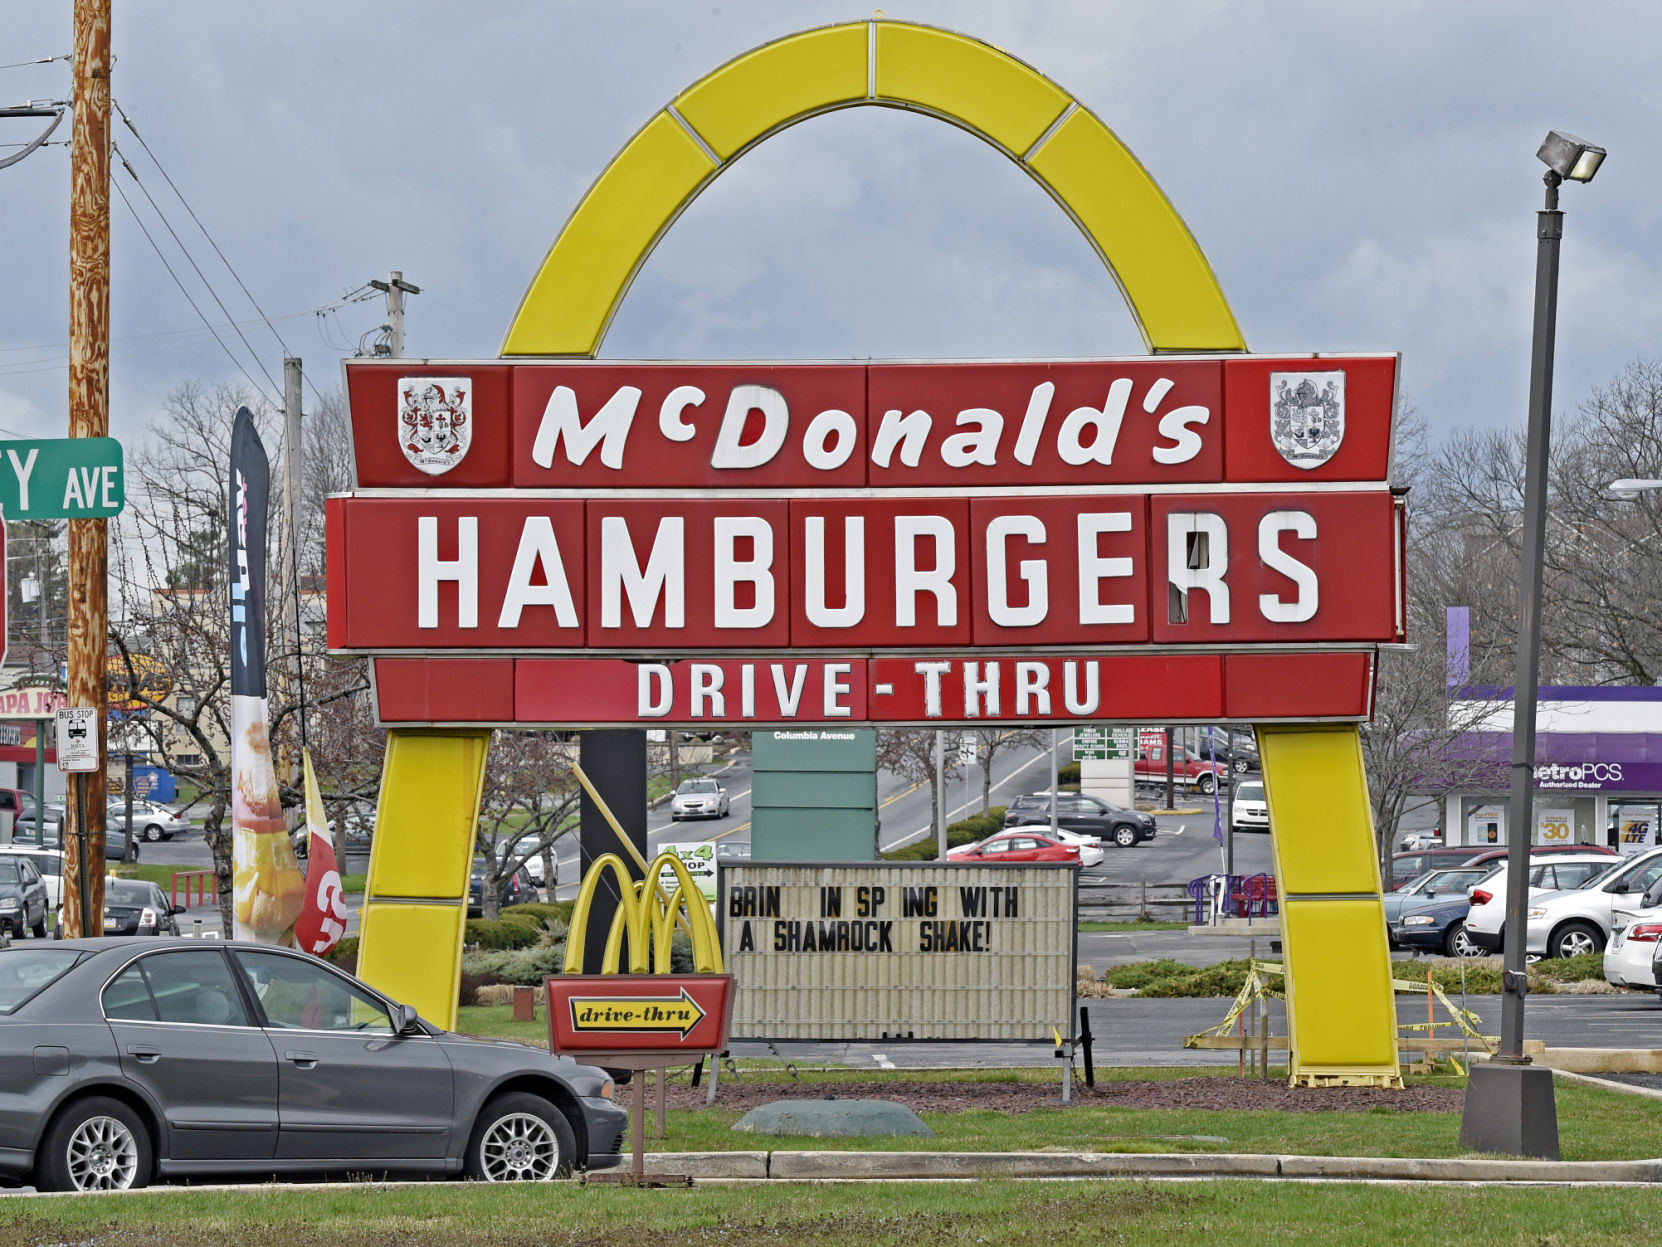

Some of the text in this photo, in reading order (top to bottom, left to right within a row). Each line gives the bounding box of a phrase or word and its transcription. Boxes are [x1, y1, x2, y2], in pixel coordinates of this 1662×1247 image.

[532, 377, 1210, 471] McDonald's
[0, 448, 118, 510] Y AVE
[417, 511, 1319, 629] HAMBURGERS
[59, 710, 93, 719] BUS STOP
[773, 731, 855, 740] Columbia Avenue
[1624, 834, 1646, 843] LTE
[1628, 822, 1649, 833] 4G
[729, 886, 780, 917] BRIN
[820, 886, 841, 917] IN
[960, 886, 1019, 917] WITH
[739, 921, 991, 952] A SHAMROCK SHAKE!
[579, 1007, 692, 1022] drive-thru
